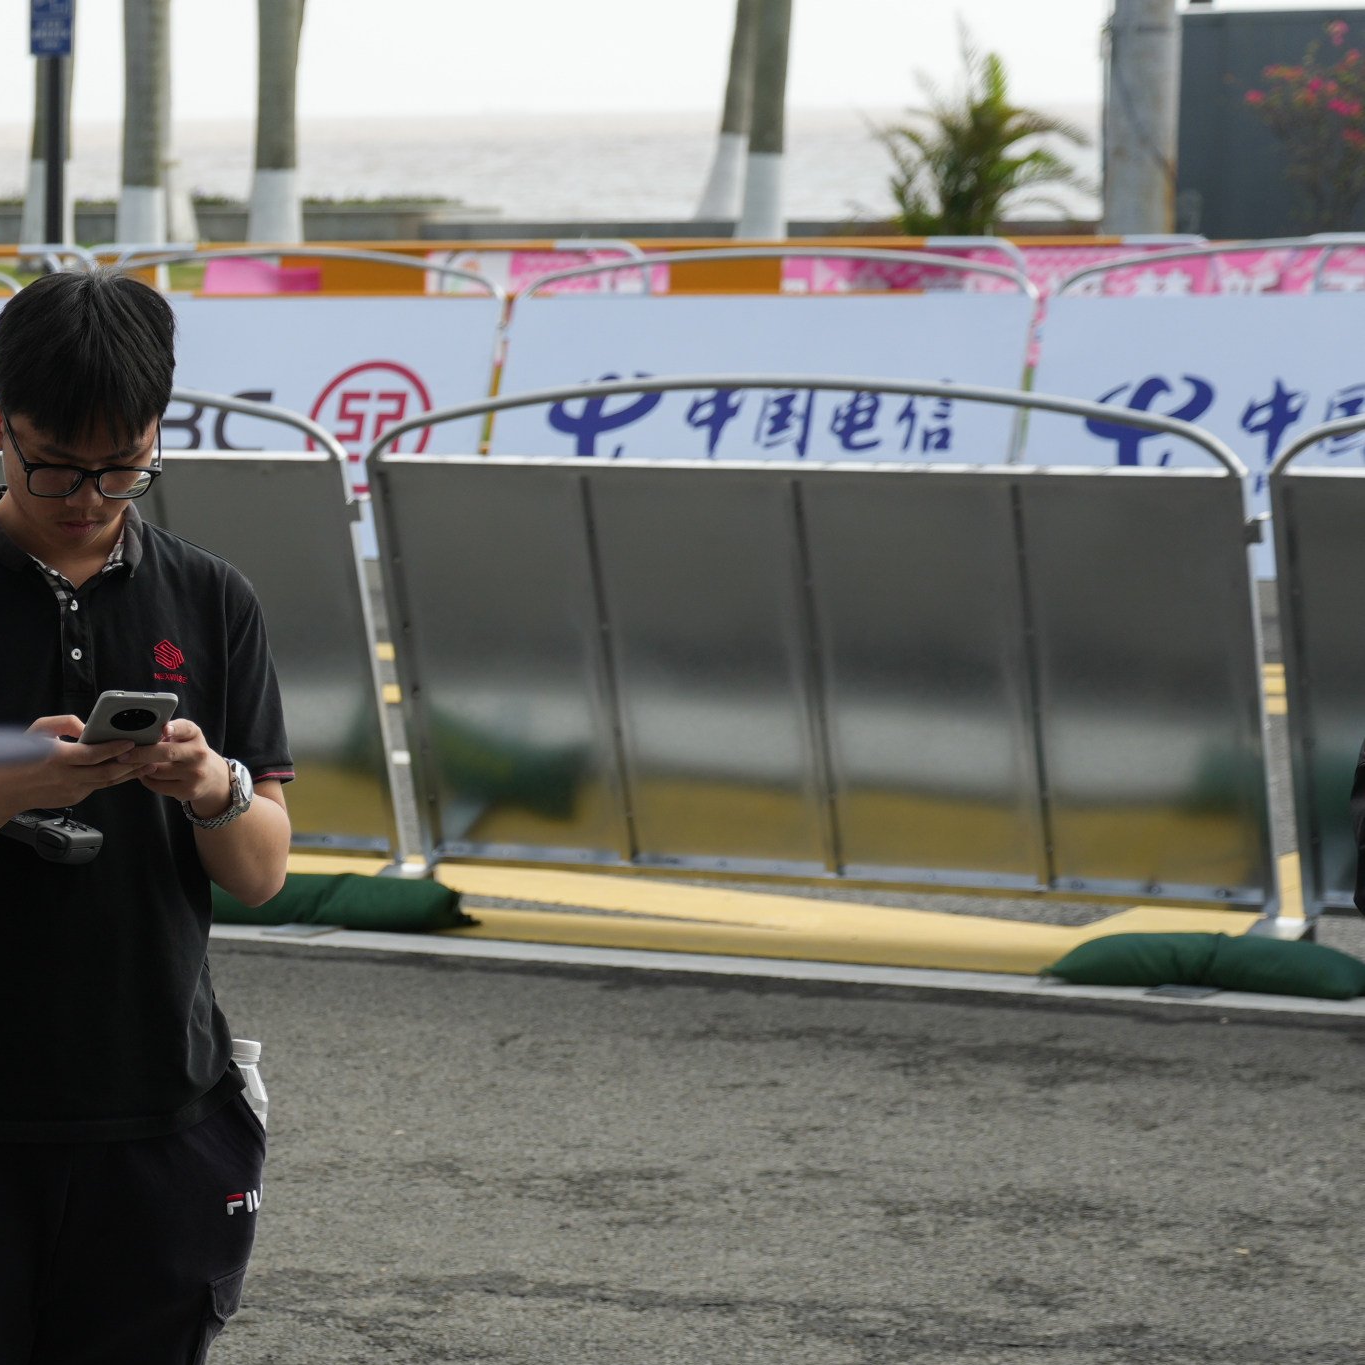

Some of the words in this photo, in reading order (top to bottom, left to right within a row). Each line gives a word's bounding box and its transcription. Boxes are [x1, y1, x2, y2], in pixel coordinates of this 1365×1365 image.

[684, 384, 956, 458] 中国电信
[226, 1183, 263, 1215] FIL
